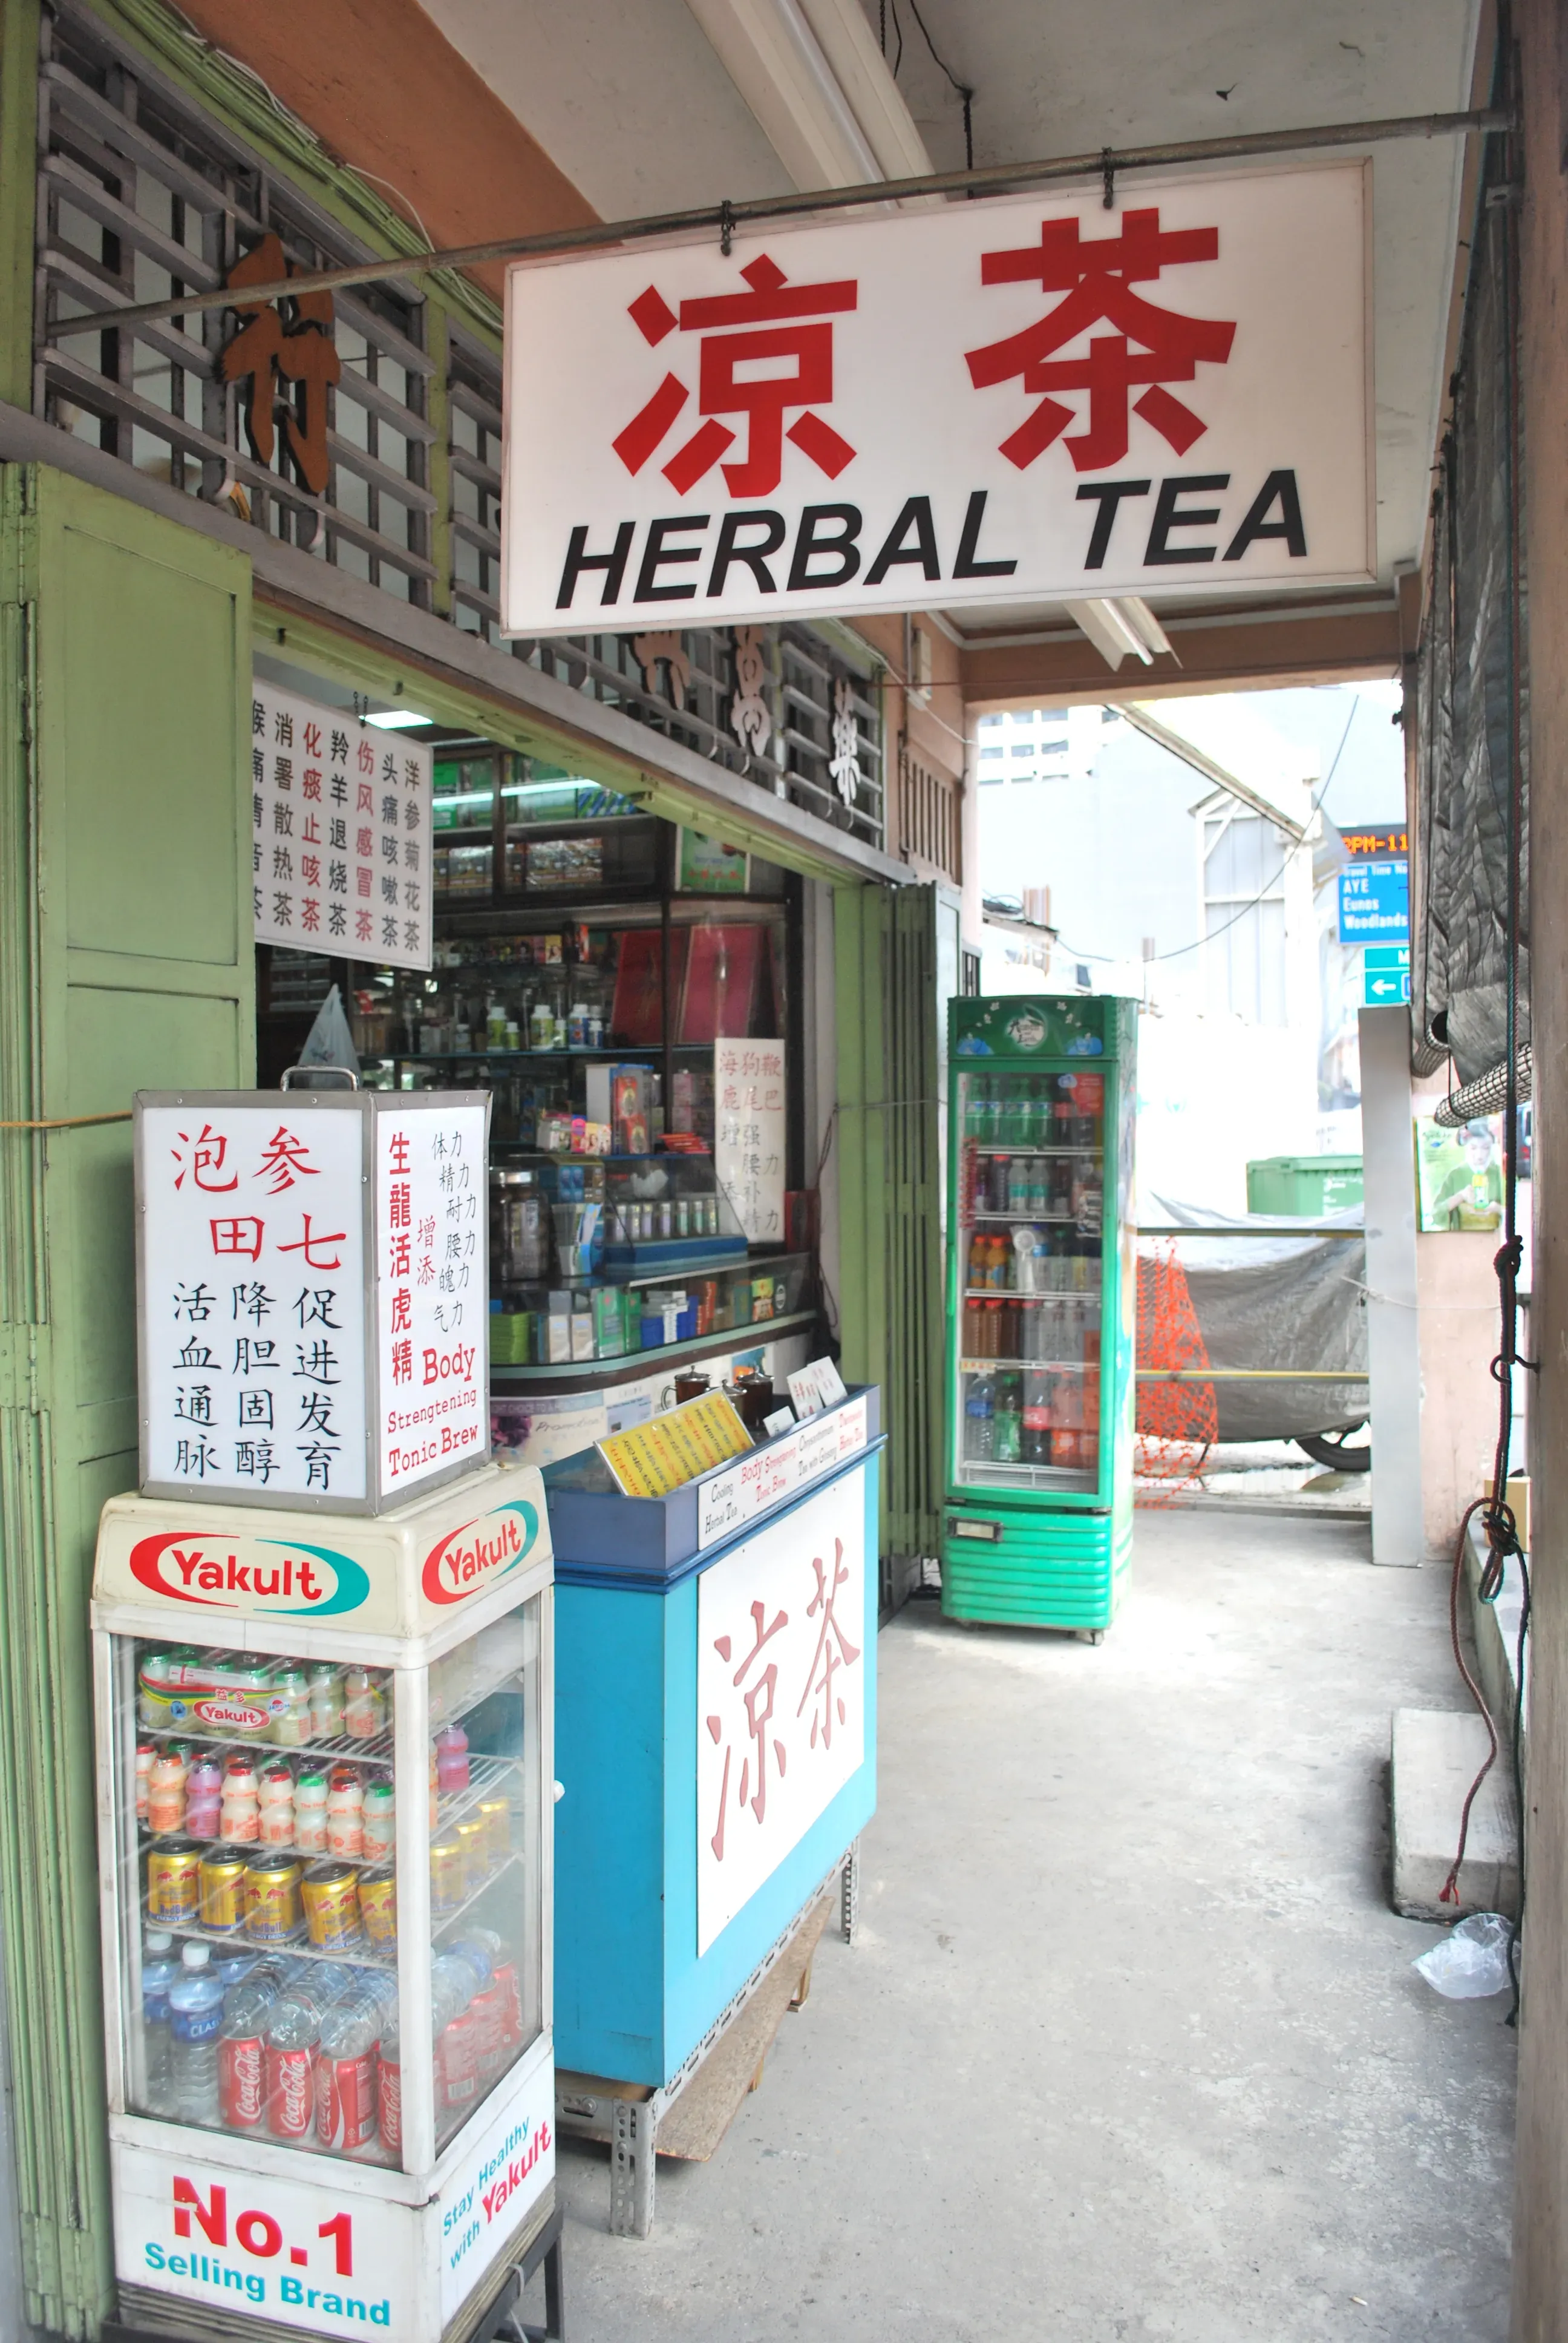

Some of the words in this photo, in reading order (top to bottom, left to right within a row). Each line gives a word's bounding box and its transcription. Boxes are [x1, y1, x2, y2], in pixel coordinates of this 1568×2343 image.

[611, 207, 1236, 499] 凉茶
[555, 490, 1018, 609] HERBAL
[1075, 469, 1308, 569] TEA
[302, 722, 322, 932] 化痰止咳茶
[328, 730, 349, 936] 羚羊退烧茶
[356, 739, 374, 942] 伤风感冒茶
[382, 753, 398, 948] 头痛咳嗽茶
[404, 759, 420, 952] 洋参菊花茶
[1342, 878, 1370, 894] AYE
[1342, 896, 1379, 912] Eunos
[1344, 912, 1408, 930] Woodlands
[719, 1085, 785, 1112] 鹿尾巴
[171, 1124, 322, 1194] 泡参
[432, 1131, 462, 1160] 体力
[721, 1122, 760, 1147] 增强
[439, 1163, 469, 1192] 精力
[742, 1153, 779, 1176] 腰力
[446, 1193, 477, 1223] 耐力
[209, 1213, 347, 1270] 田七
[389, 1131, 413, 1386] 生龍活虎精
[417, 1214, 436, 1287] 增添
[445, 1230, 476, 1261] 腰力
[439, 1262, 469, 1293] 魄力
[434, 1300, 463, 1332] 气力
[172, 1282, 222, 1476] 活血通脉
[232, 1281, 281, 1485] 降胆固醇
[291, 1287, 343, 1490] 促进发育
[422, 1343, 475, 1386] Body
[388, 1389, 477, 1434] Strengtening
[389, 1441, 437, 1477] Tonic
[441, 1424, 478, 1455] Brew
[741, 1459, 763, 1485] Body
[705, 1512, 725, 1535] Herbal
[727, 1501, 738, 1521] Tea
[711, 1483, 734, 1502] Cooling
[171, 1549, 323, 1601] Yakult
[444, 1519, 522, 1586] Yakult
[204, 1705, 260, 1724] Yakult
[443, 2184, 474, 2237] Stay
[478, 2115, 530, 2191] Healthy
[450, 2219, 480, 2270] with
[482, 2120, 552, 2225] Yakult
[173, 2175, 353, 2277] No.1
[145, 2242, 266, 2303] Selling
[279, 2275, 391, 2327] Brand
